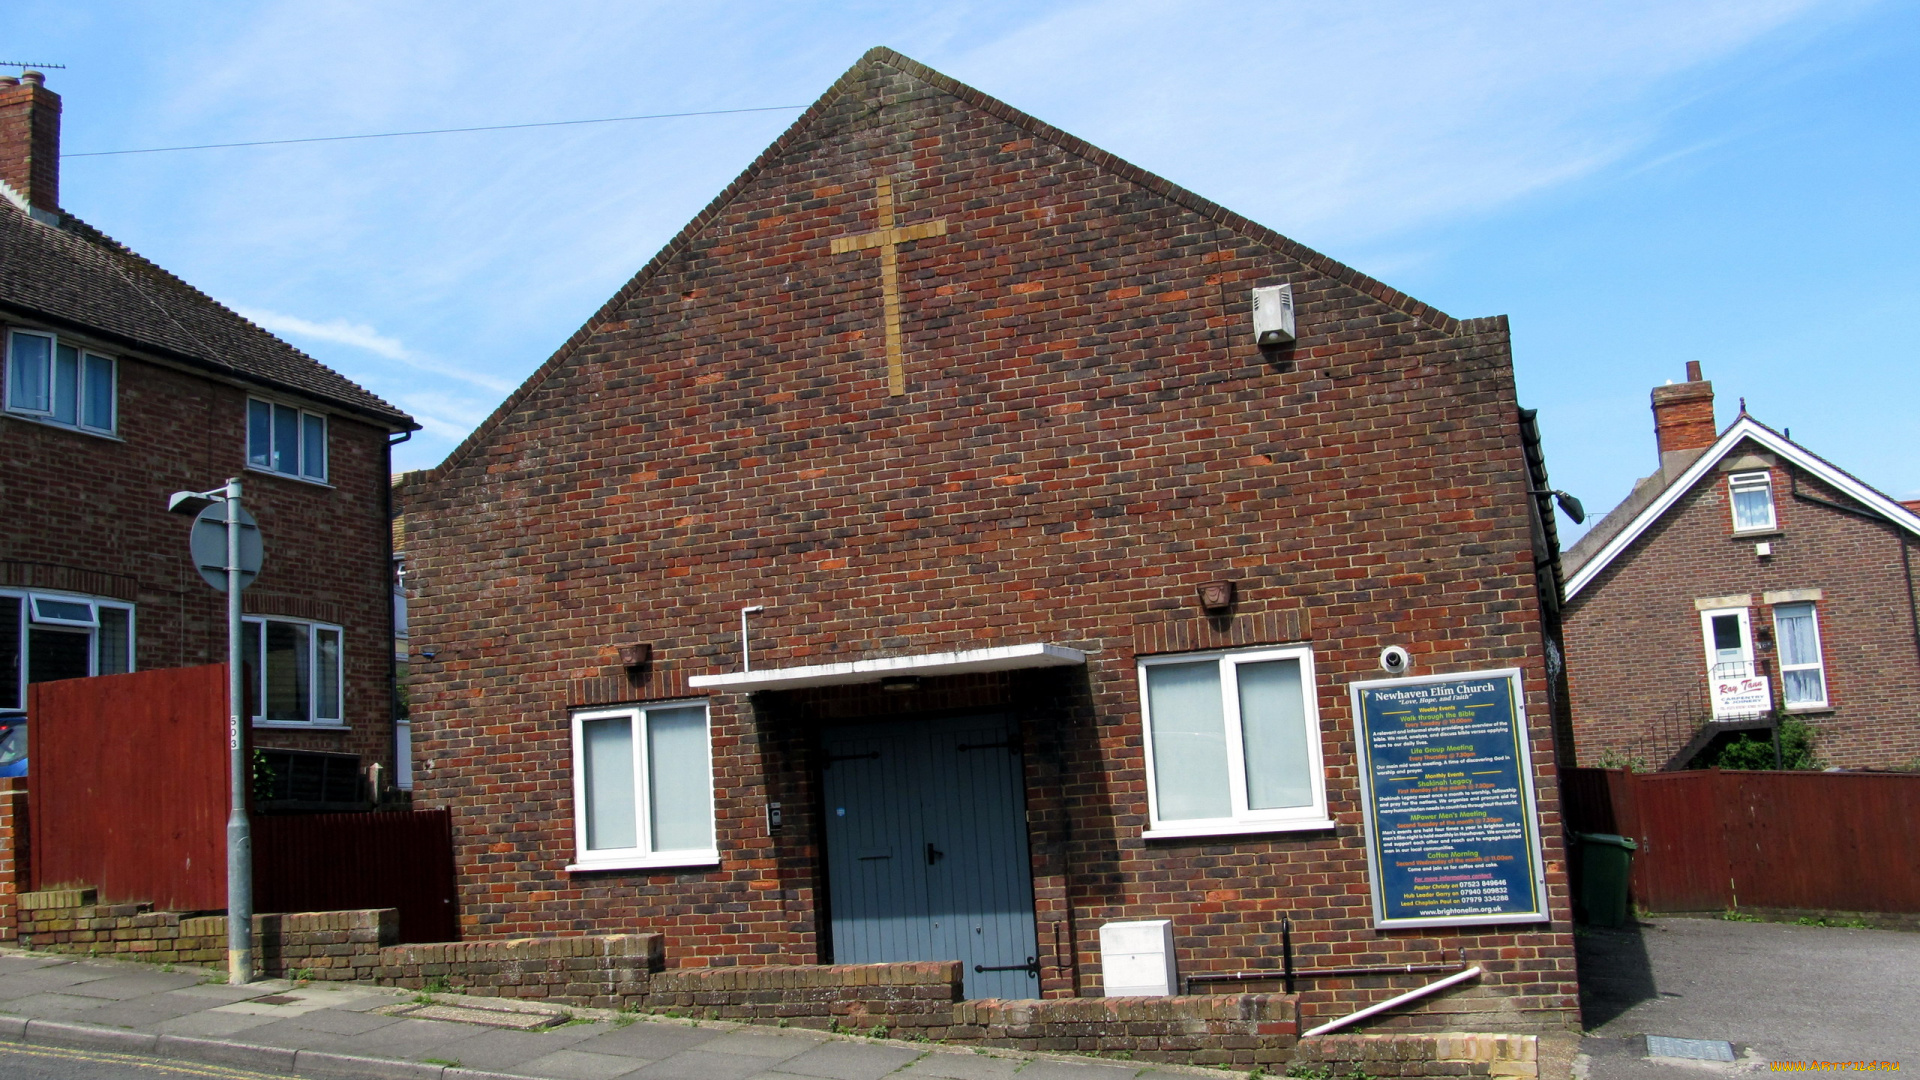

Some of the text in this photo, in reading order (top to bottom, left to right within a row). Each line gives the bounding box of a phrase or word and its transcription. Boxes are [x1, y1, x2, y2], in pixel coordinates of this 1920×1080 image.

[1375, 683, 1494, 700] Newhaven Elim Church
[1719, 679, 1762, 695] Ray Tann
[1418, 714, 1443, 722] through
[1446, 744, 1474, 752] Meeting
[1420, 906, 1502, 916] www.brightonelim.org.uk
